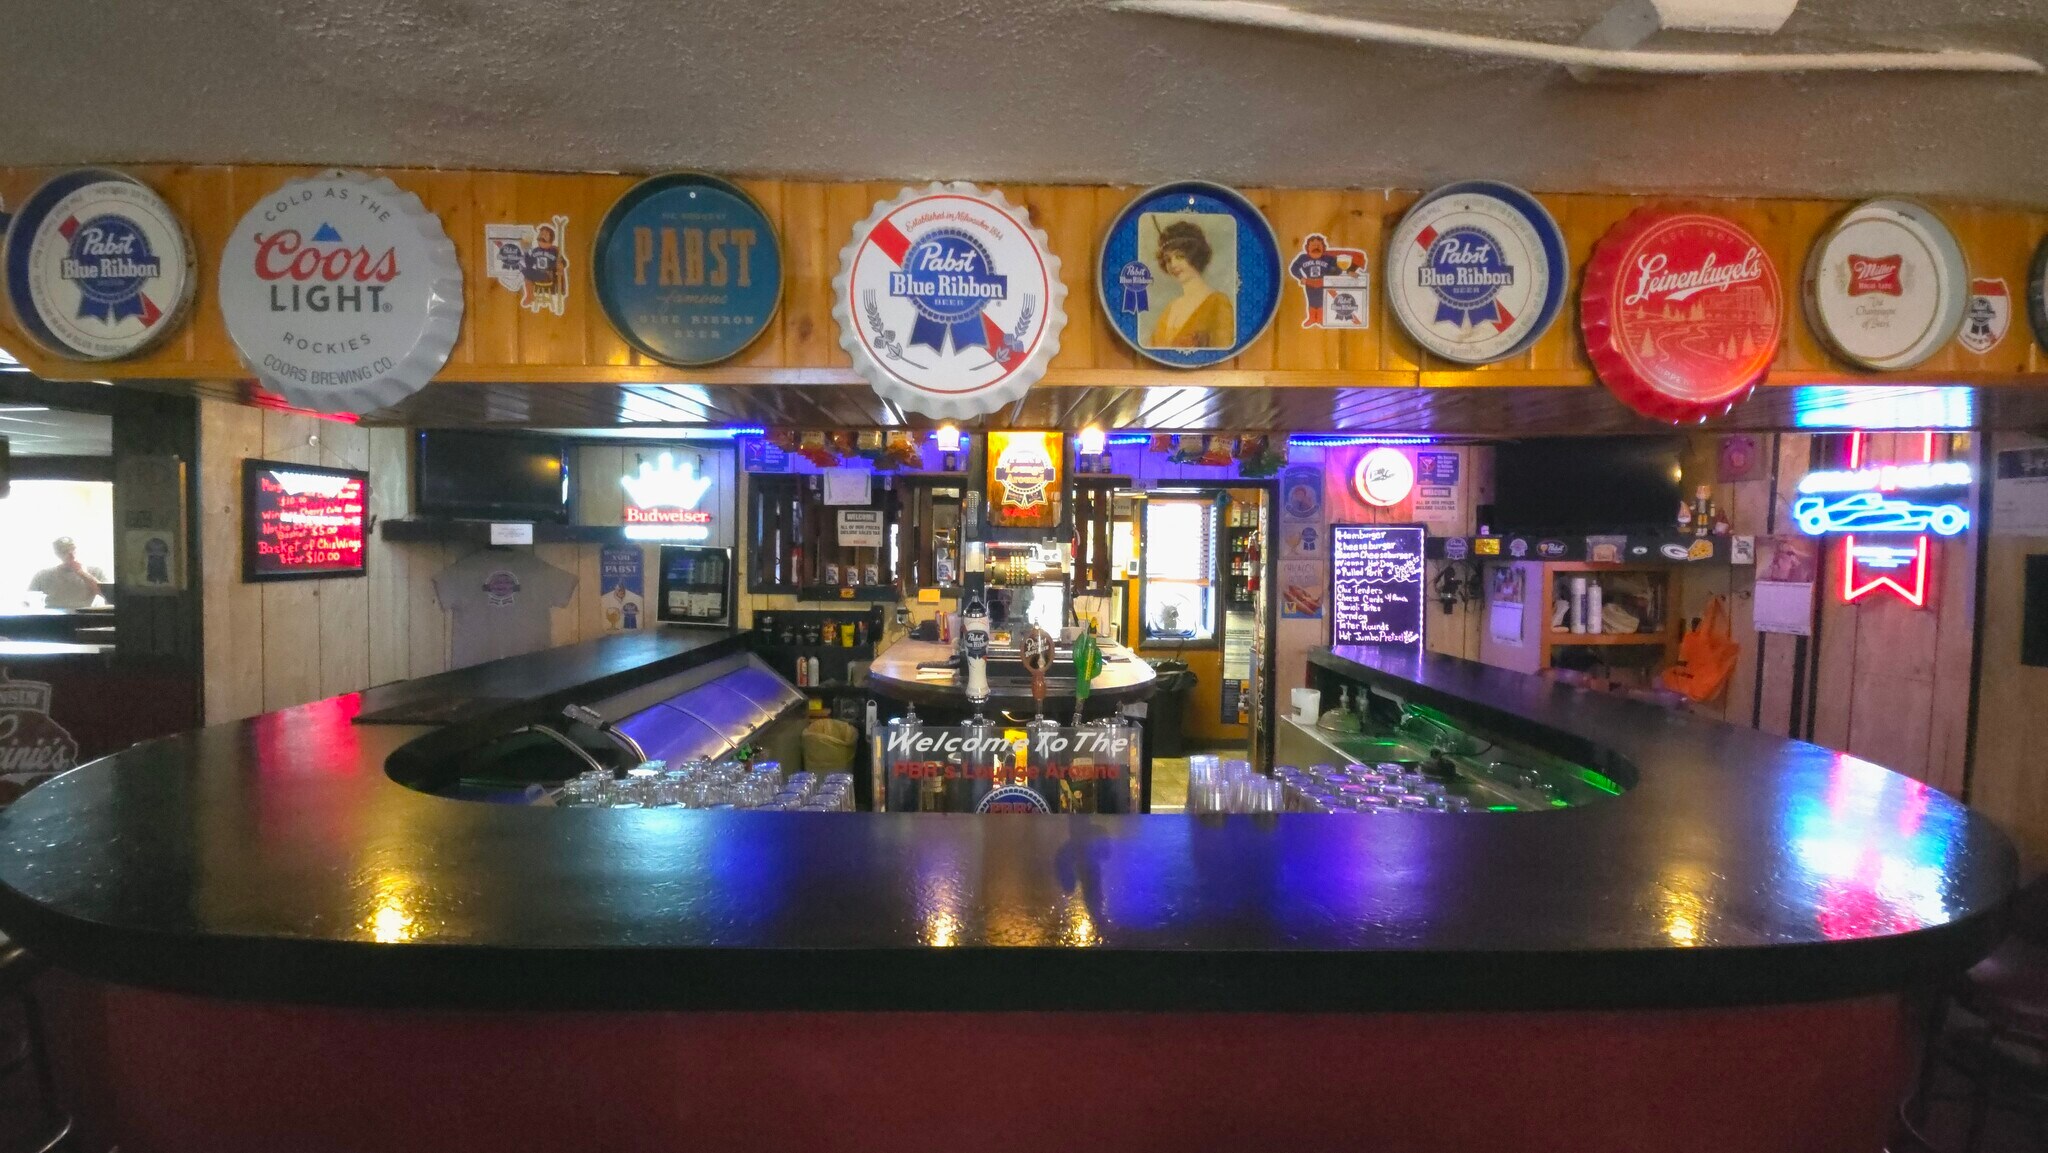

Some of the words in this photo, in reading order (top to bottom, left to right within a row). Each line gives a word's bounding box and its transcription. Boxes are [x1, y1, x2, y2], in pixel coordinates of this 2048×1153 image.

[265, 190, 313, 222] COLD
[326, 188, 348, 200] AS
[358, 195, 391, 223] THE
[905, 211, 945, 233] Established
[81, 228, 136, 255] Pabst
[1439, 238, 1491, 263] Pabst
[254, 229, 401, 282] Coors
[633, 227, 758, 287] PABST
[920, 241, 977, 272] Pabst
[63, 258, 98, 279] Blue
[100, 258, 158, 278] Ribbon
[1127, 265, 1145, 276] Pabst
[1420, 267, 1454, 286] Blue
[1457, 266, 1511, 285] Ribbon
[1625, 247, 1762, 305] Leinenkugel's
[1854, 261, 1896, 280] Miller
[893, 273, 935, 296] Blue
[938, 274, 1003, 299] Ribbon
[270, 284, 385, 312] LIGHT
[639, 316, 681, 324] BLUE
[691, 316, 755, 325] RIBBON
[283, 331, 371, 354] ROCKIES
[674, 331, 721, 339] BEER
[263, 354, 307, 382] COORS
[311, 368, 372, 385] BREWING
[627, 508, 709, 522] Budweiser
[258, 540, 300, 555] Basket
[302, 539, 315, 551] of
[605, 565, 636, 573] PABST
[1341, 567, 1364, 576] Pulled
[1365, 566, 1384, 577] Pork
[1337, 594, 1360, 602] Cheese
[1352, 584, 1383, 594] Tenders
[1361, 603, 1381, 612] Bites
[1337, 620, 1360, 629] Tater
[1360, 621, 1389, 631] Rounds
[967, 632, 984, 642] Pabst
[1339, 631, 1351, 641] Hot
[1353, 632, 1379, 641] Jumbo
[1379, 631, 1403, 642] Pretzel
[886, 731, 1030, 752] Welcome
[1035, 731, 1068, 752] To
[1073, 731, 1129, 752] The
[893, 761, 955, 779] PBR's
[963, 761, 1039, 783] Lounge
[1046, 761, 1121, 779] Around
